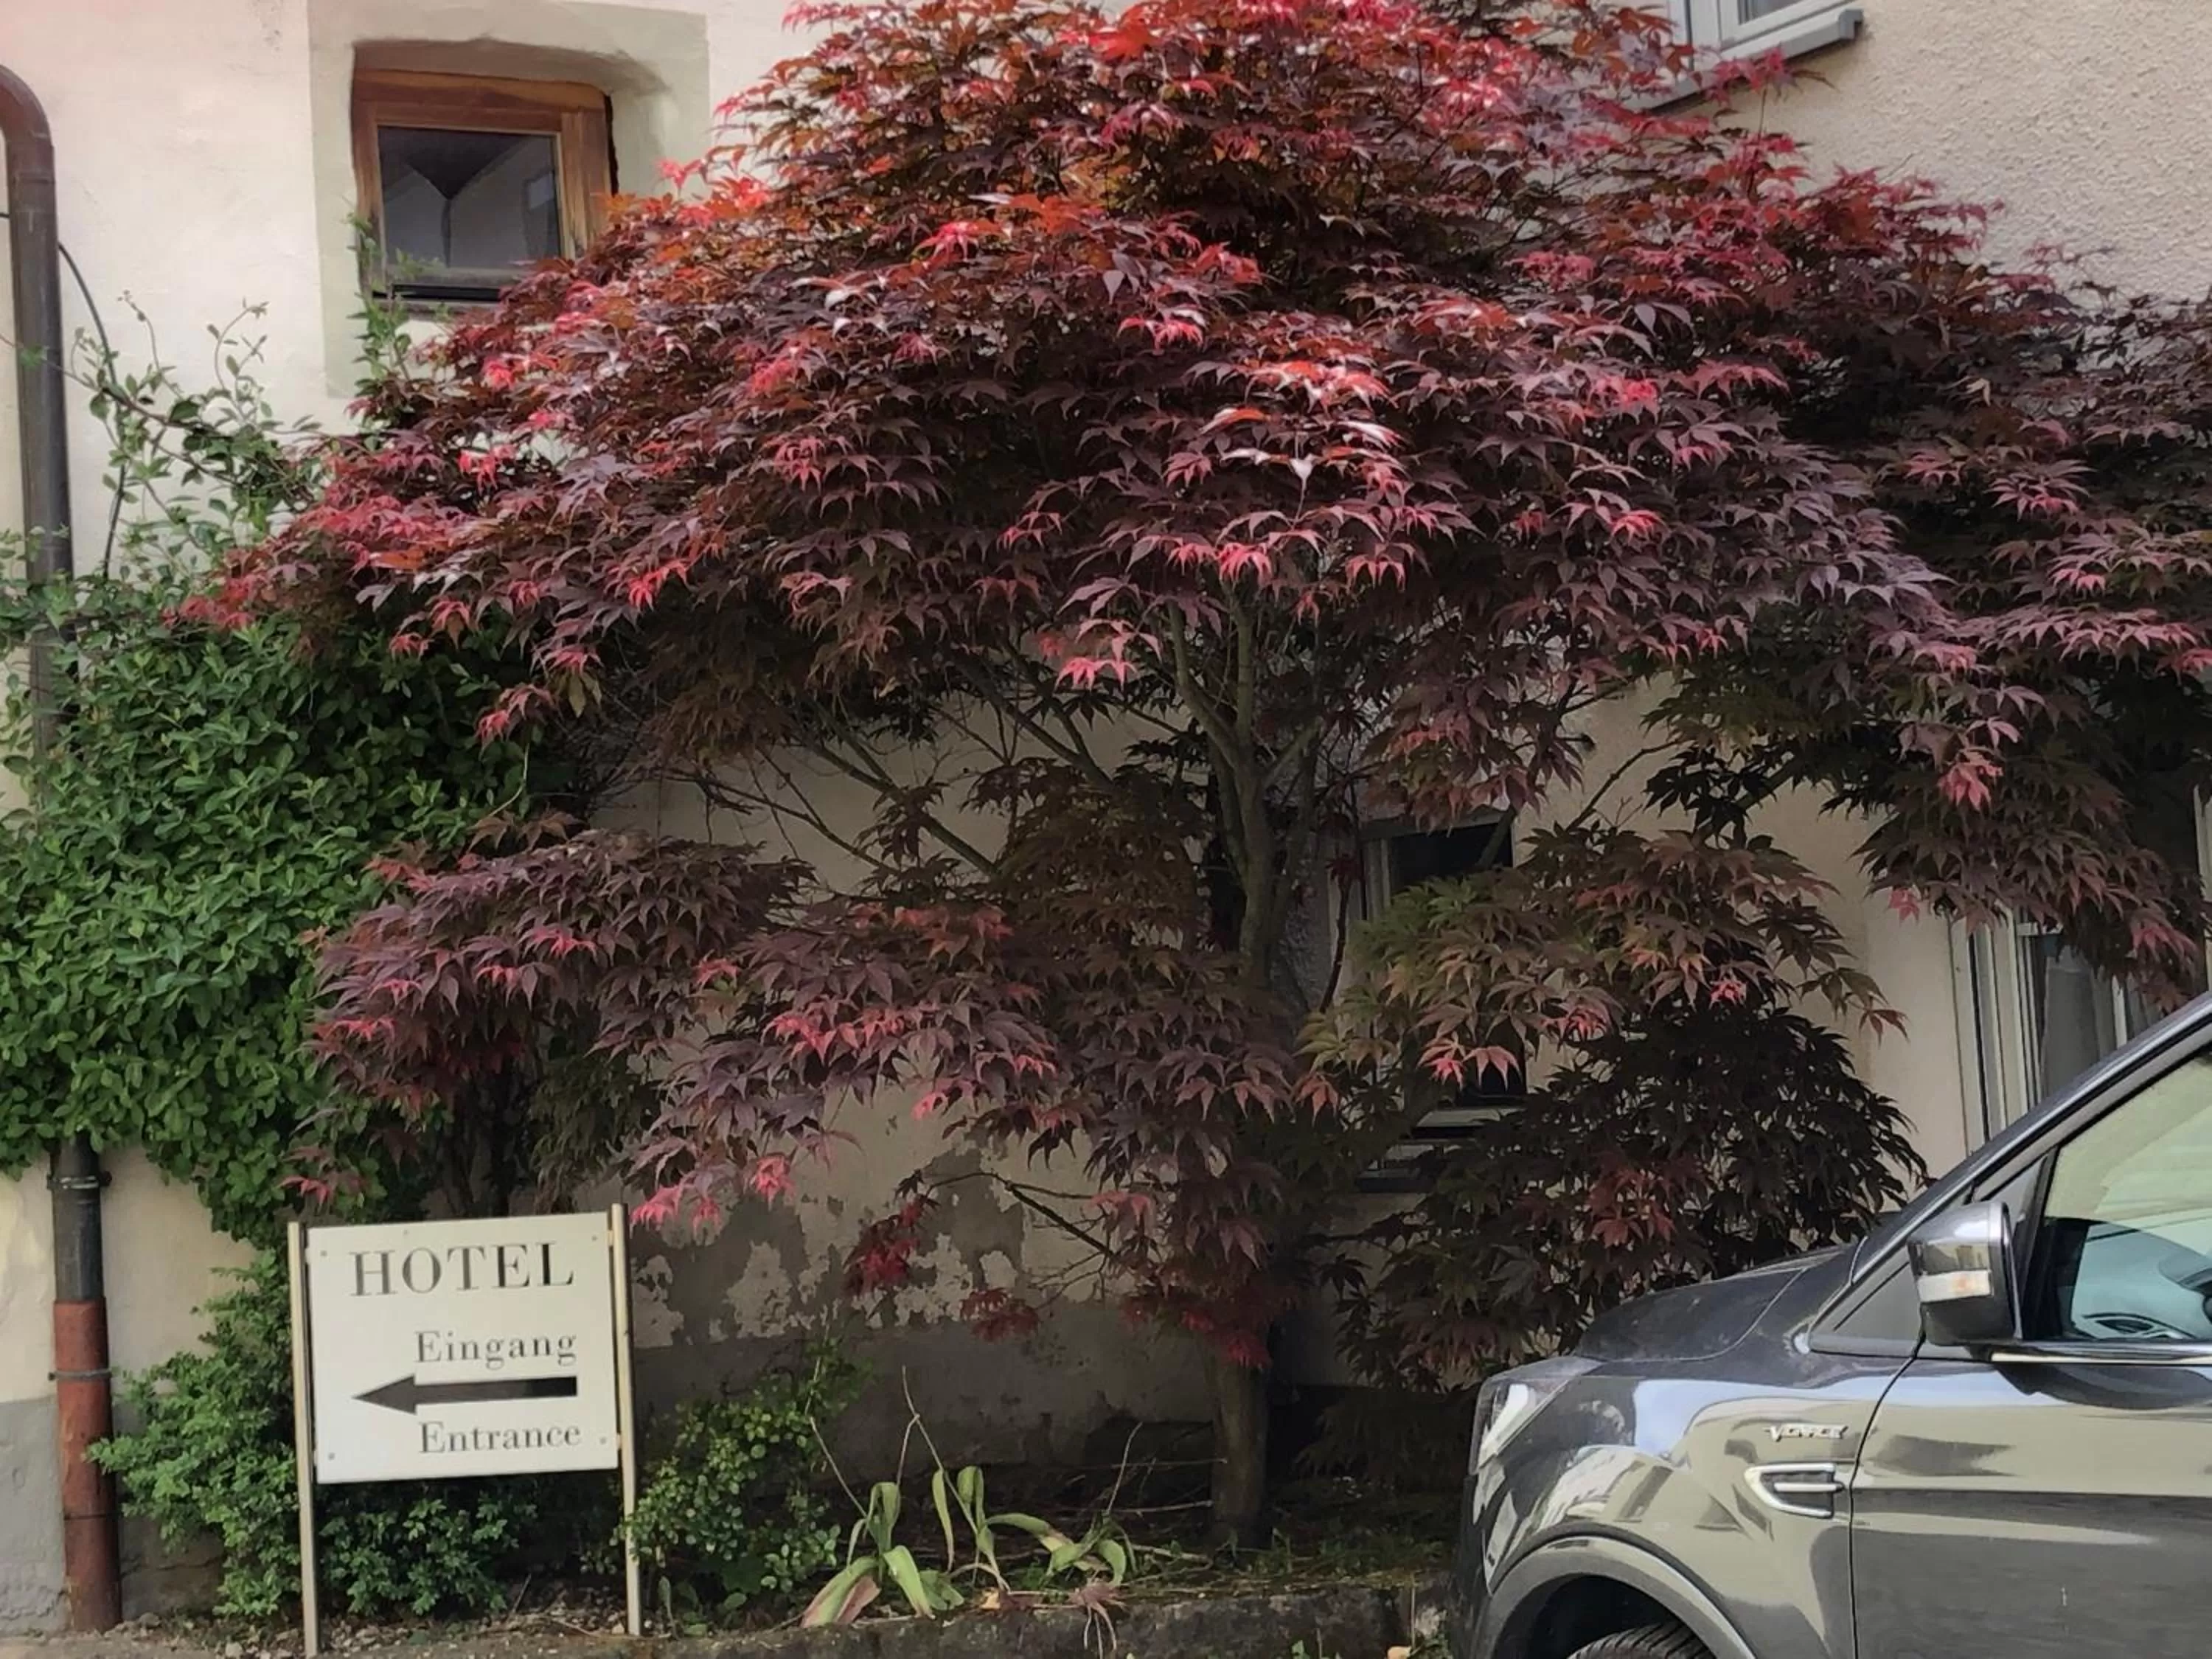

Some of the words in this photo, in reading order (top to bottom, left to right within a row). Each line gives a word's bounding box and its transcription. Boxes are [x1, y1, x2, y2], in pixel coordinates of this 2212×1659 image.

[349, 1242, 574, 1296] HOTEL
[415, 1330, 577, 1369] Eingang
[419, 1422, 580, 1453] Entrance
